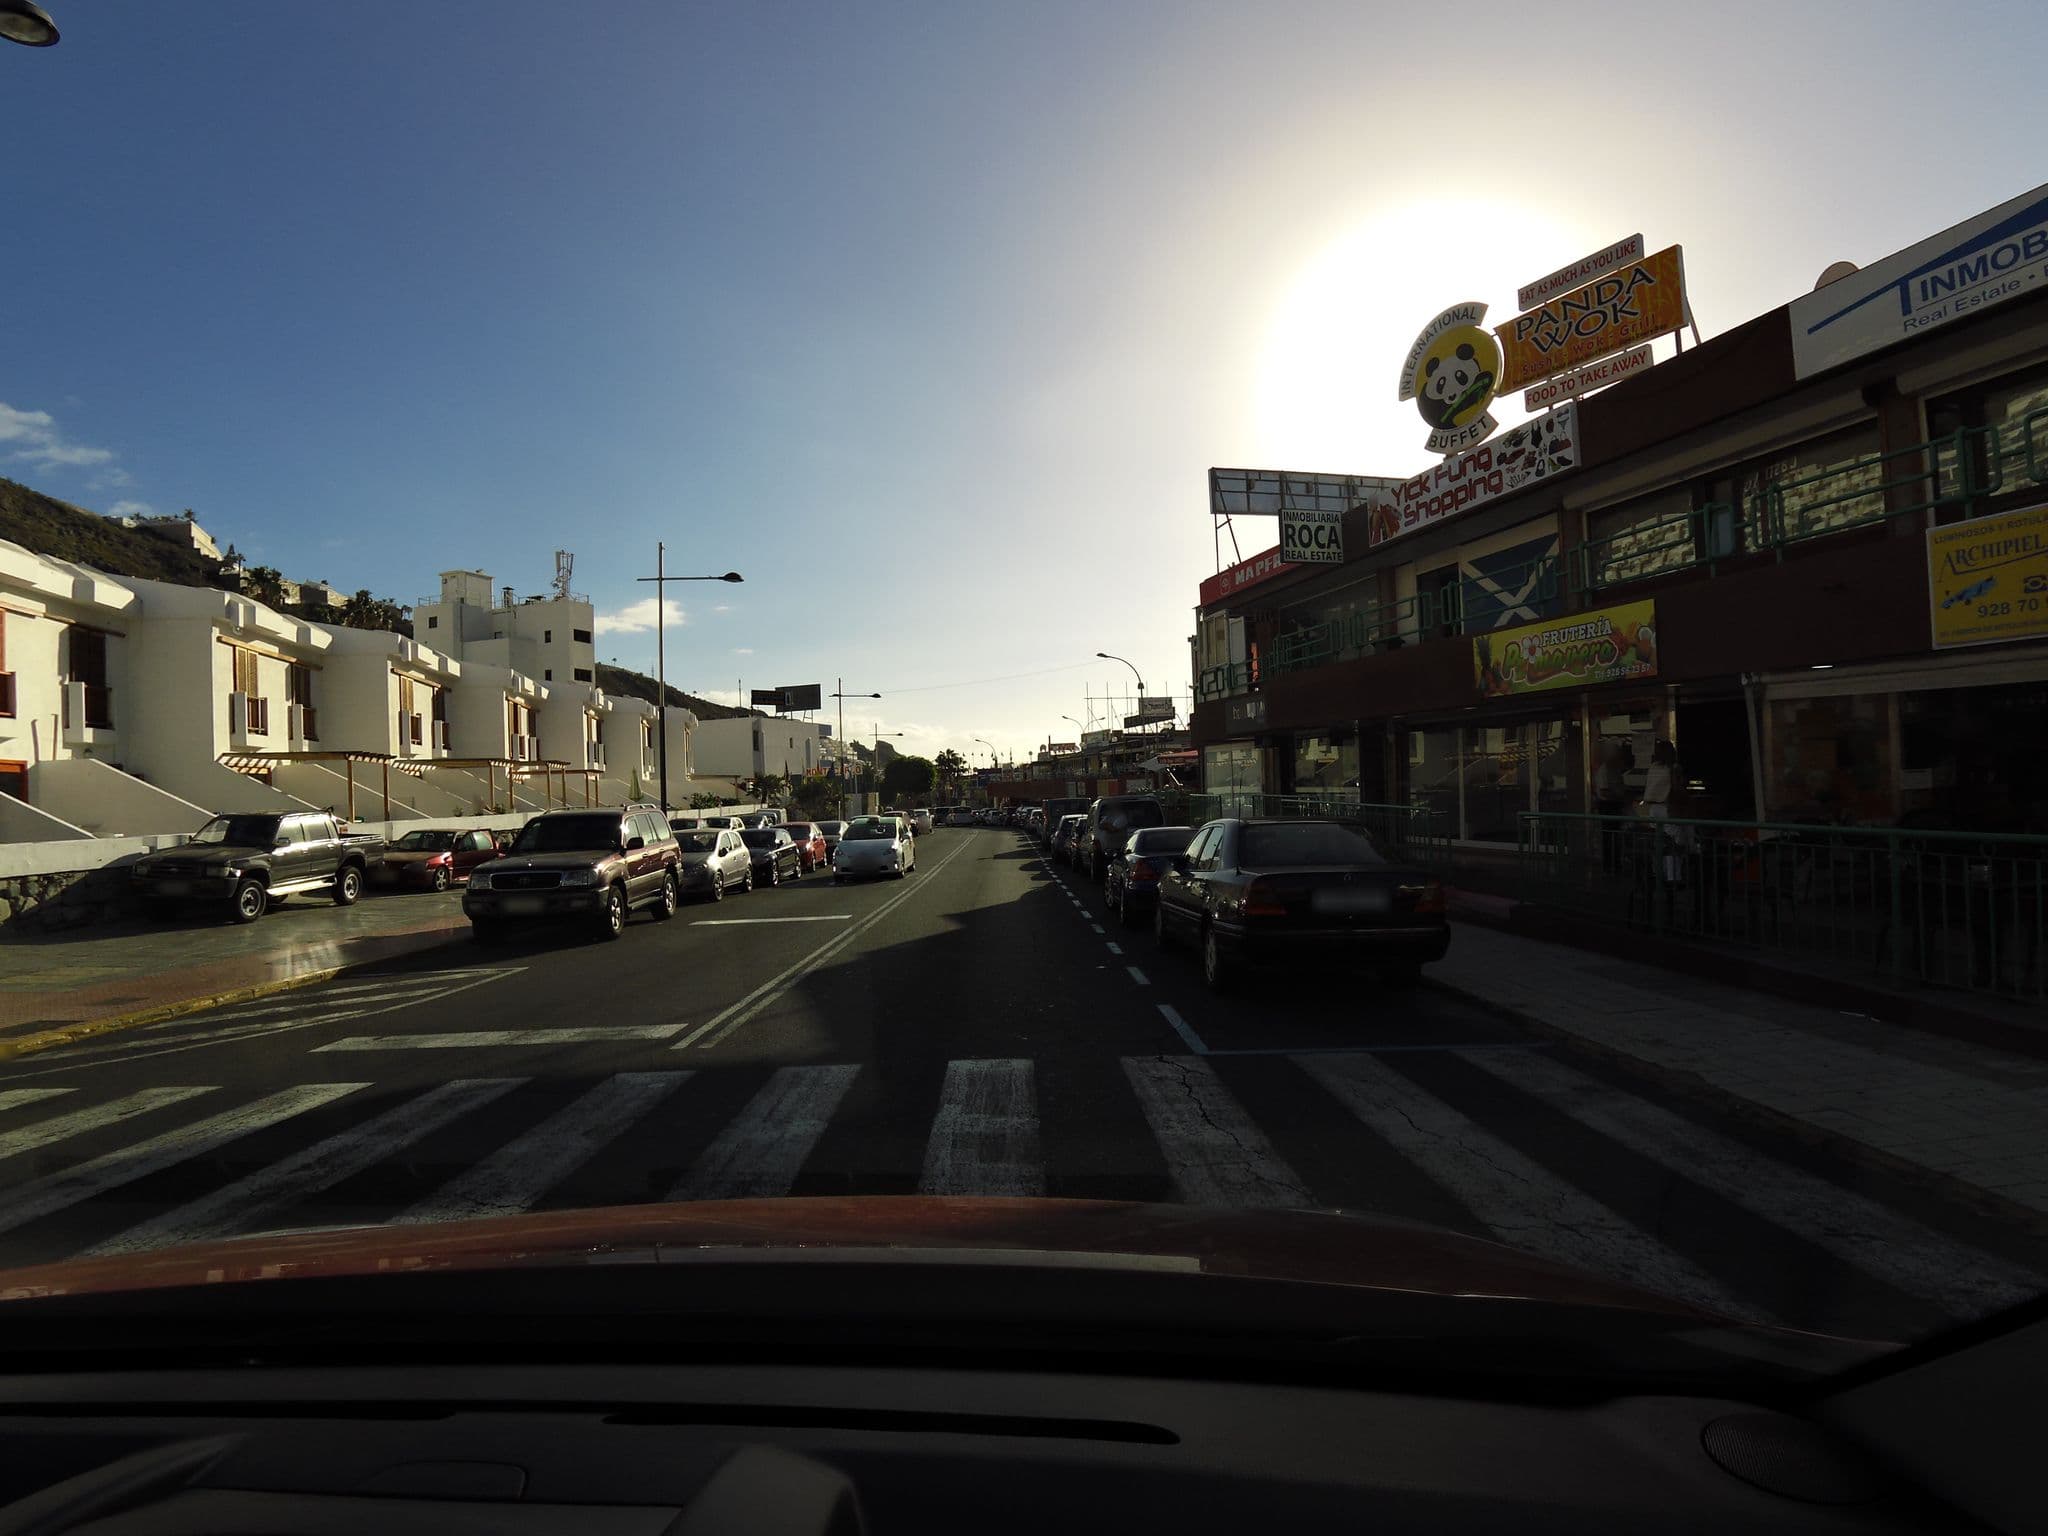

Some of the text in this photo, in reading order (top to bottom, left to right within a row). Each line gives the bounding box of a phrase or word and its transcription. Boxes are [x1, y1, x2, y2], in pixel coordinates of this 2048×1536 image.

[1520, 240, 1636, 304] EAT AS MUCH AS YOU LIKE
[1516, 267, 1655, 340] PANDA
[1904, 280, 2020, 332] Real Estate
[1532, 296, 1638, 353] WOK
[1401, 305, 1476, 395] INTERNATIONAL
[1526, 385, 1557, 405] FOOD
[1560, 378, 1575, 393] TO
[1579, 365, 1608, 386] TAKE
[1612, 350, 1647, 375] AWAY
[1429, 416, 1487, 449] BUFFET
[1283, 511, 1340, 523] INMOBILIARIA
[1284, 524, 1341, 549] ROCA
[1234, 553, 1284, 585] MAPFR
[1285, 550, 1343, 561] REAL ESTATE
[1978, 602, 2010, 618] 928
[2018, 598, 2039, 613] 70
[1542, 617, 1613, 647] FRUTERÍA
